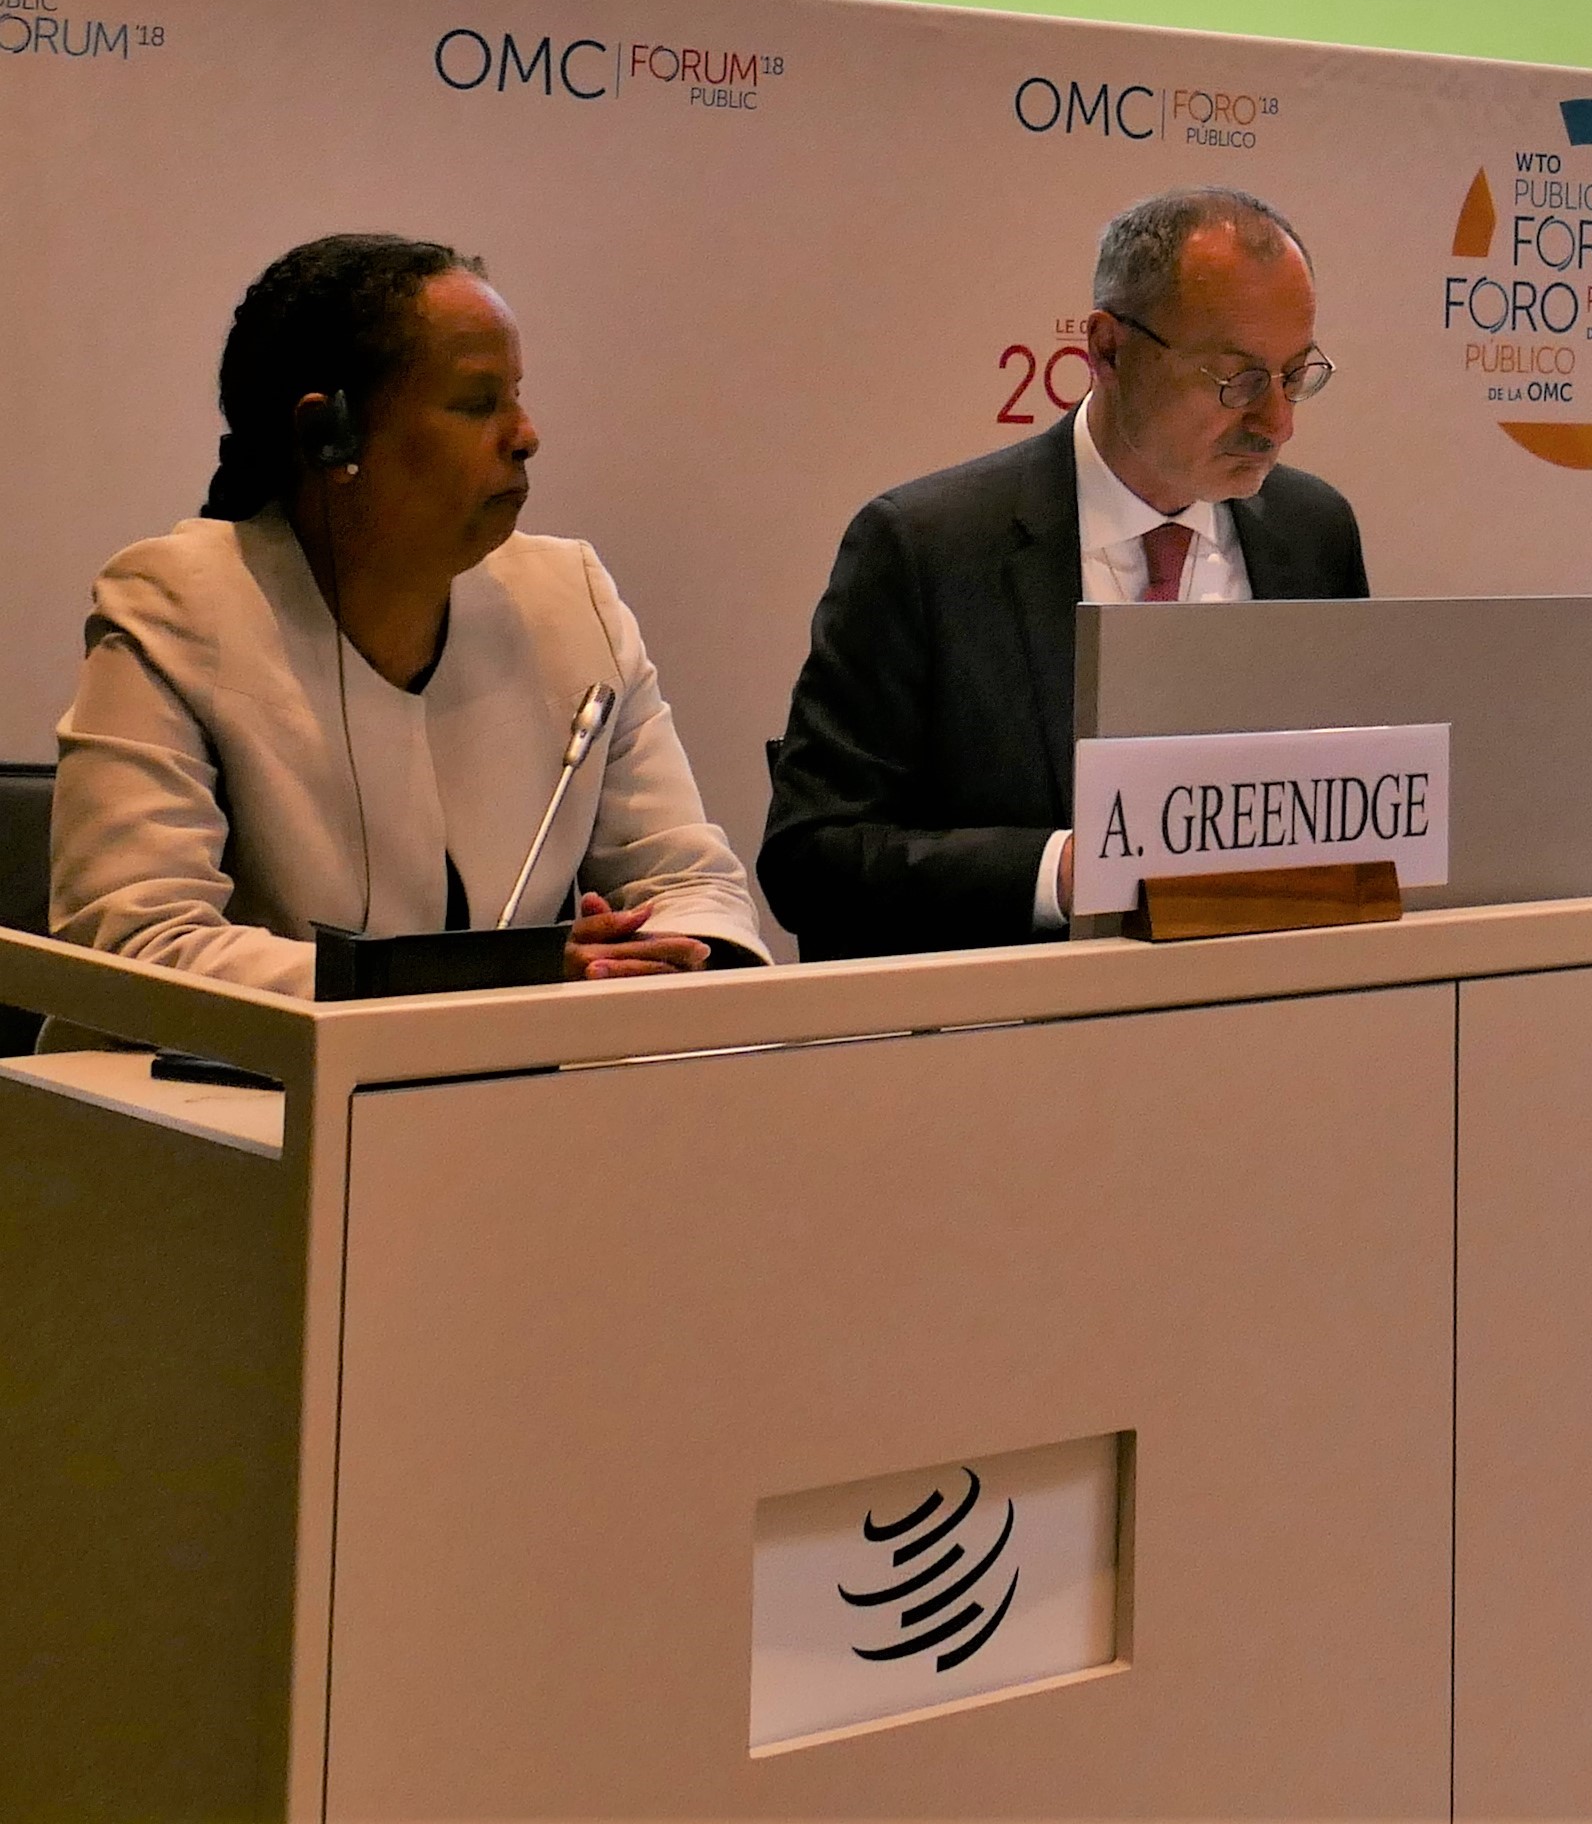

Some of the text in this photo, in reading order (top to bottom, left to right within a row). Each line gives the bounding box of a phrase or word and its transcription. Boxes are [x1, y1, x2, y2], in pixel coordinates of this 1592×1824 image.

[435, 29, 606, 99] OMC
[690, 87, 758, 111] PUBLIC
[1015, 77, 1154, 139] OMC
[1515, 152, 1561, 174] WTO
[1445, 277, 1579, 334] FORO
[1056, 319, 1075, 334] LE
[1465, 339, 1575, 375] PÚBLICO
[1488, 382, 1573, 402] DE LA OMC
[1098, 773, 1430, 858] A. GREENIDGE
